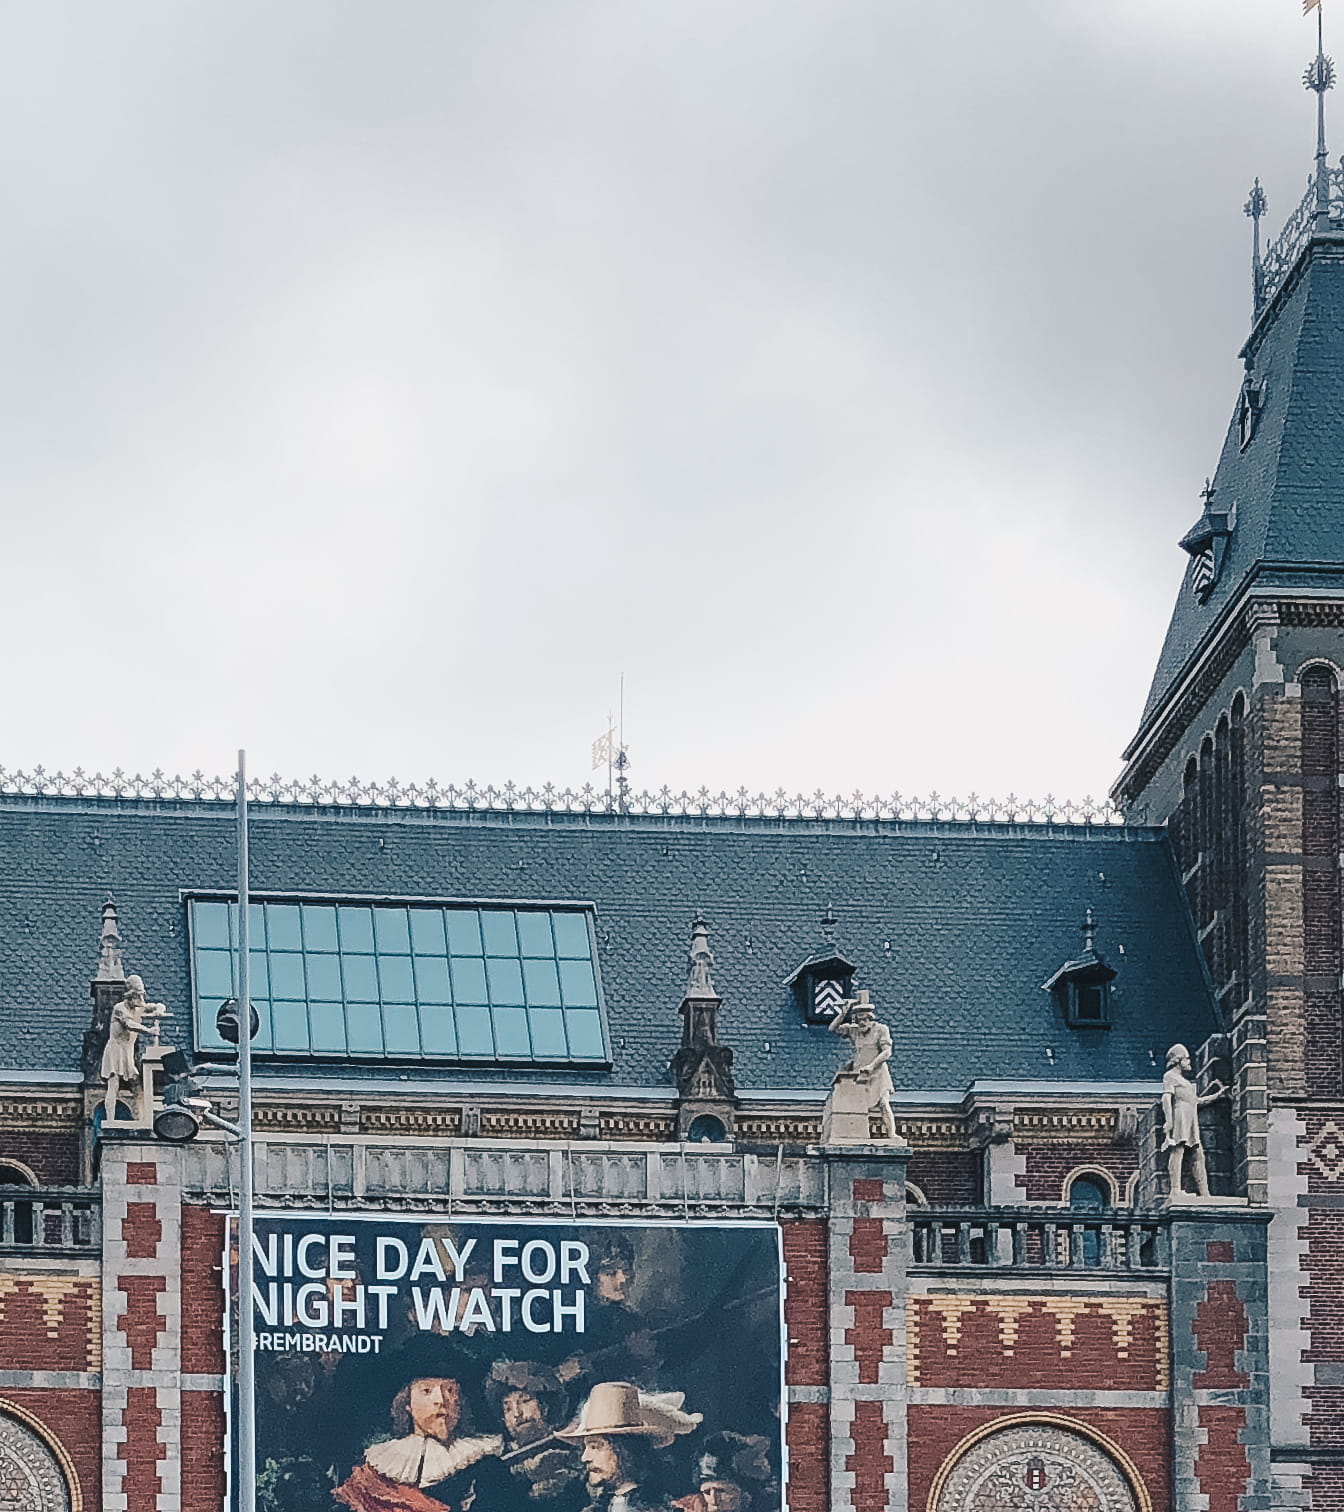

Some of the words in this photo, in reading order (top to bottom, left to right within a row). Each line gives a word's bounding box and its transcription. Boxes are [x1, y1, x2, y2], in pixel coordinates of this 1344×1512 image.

[252, 1233, 356, 1280] NICE
[376, 1236, 477, 1282] DAY
[493, 1239, 591, 1284] FOR
[252, 1280, 398, 1329] NIGHT
[411, 1286, 585, 1333] WATCH
